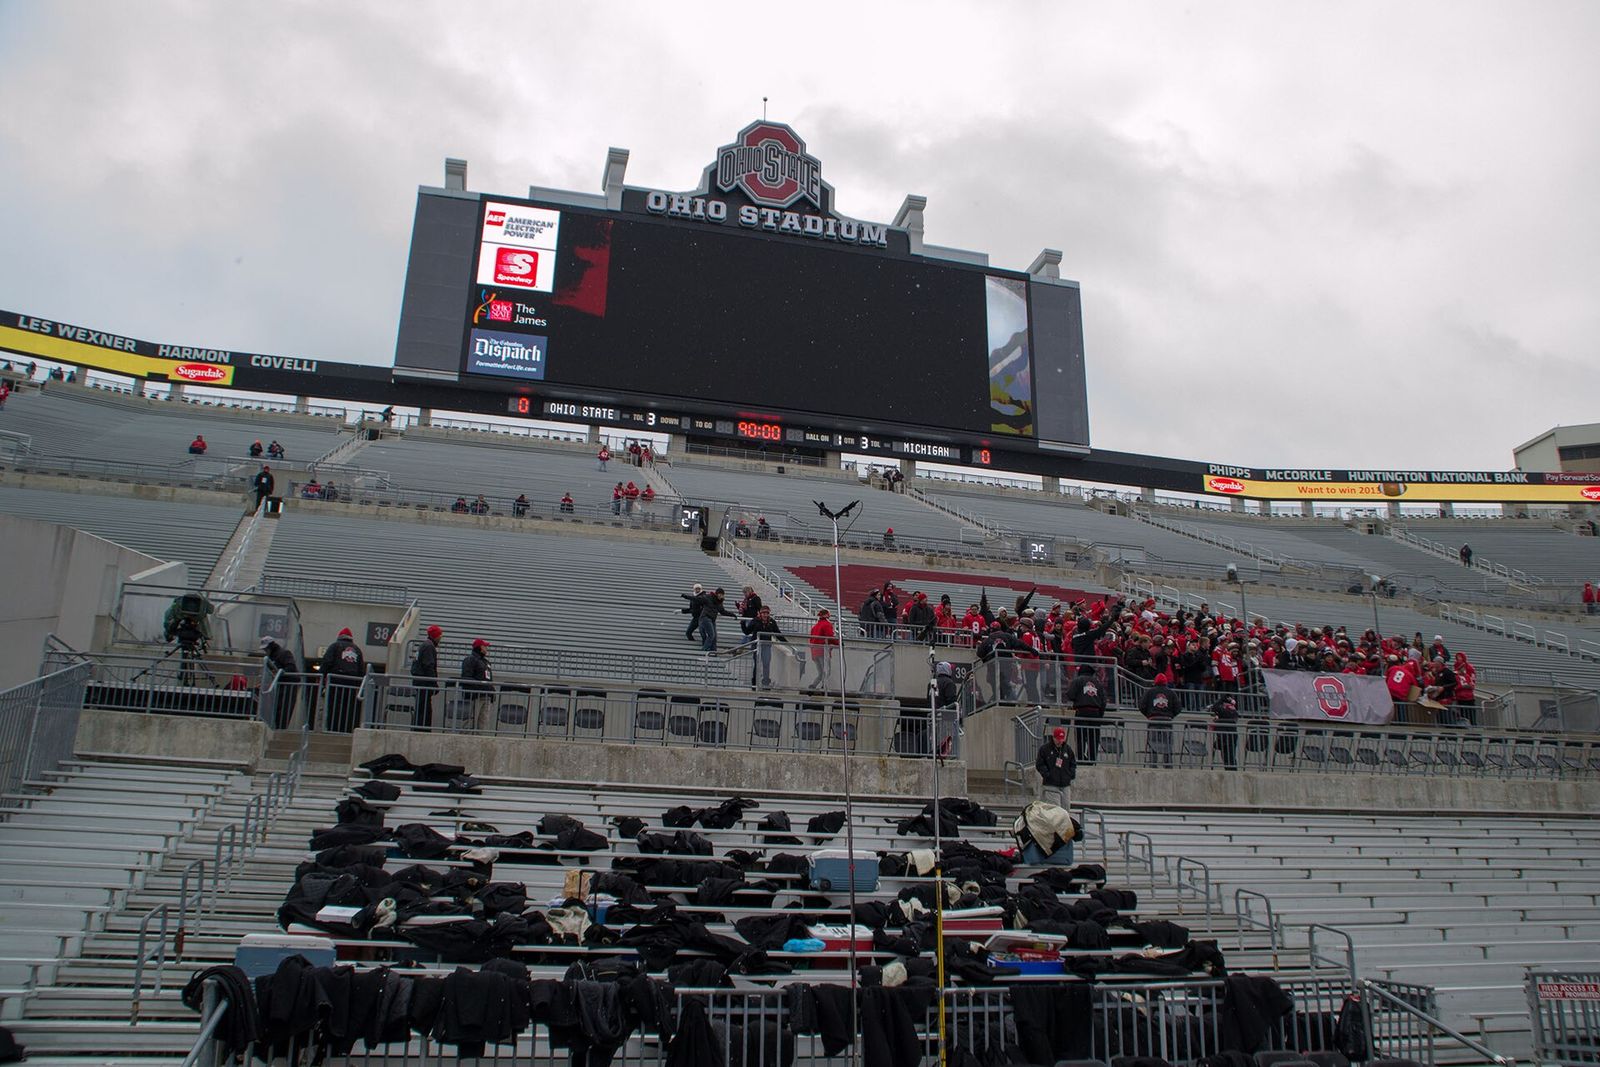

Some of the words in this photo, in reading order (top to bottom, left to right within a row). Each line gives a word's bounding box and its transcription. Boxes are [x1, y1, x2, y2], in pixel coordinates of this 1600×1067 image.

[508, 217, 554, 228] AMERICAN
[647, 191, 727, 222] OHIO
[739, 205, 888, 248] STADIUM
[505, 224, 543, 233] ELECTRIC
[504, 231, 535, 240] POWER
[496, 274, 533, 284] Speedway
[515, 303, 536, 315] The
[514, 315, 547, 327] James
[17, 315, 52, 333] LES
[57, 324, 136, 352] WEXNER
[158, 344, 230, 363] HARMON
[474, 338, 541, 362] Dispatch
[250, 354, 317, 373] COVELLI
[176, 366, 226, 380] Sugardale
[518, 397, 529, 414] 0
[550, 402, 576, 415] OHIO
[582, 407, 614, 420] STATE
[647, 412, 656, 426] 3
[660, 416, 679, 426] DOWN
[695, 420, 703, 428] TO
[738, 421, 781, 441] 90:00
[861, 437, 869, 449] 3
[904, 442, 949, 456] MICHIGAN
[981, 450, 991, 464] 0
[1209, 464, 1251, 479] PHIPPS
[1266, 470, 1332, 481] McCORKLE
[1348, 471, 1428, 483] HUNTINGTON
[1432, 472, 1491, 483] NATIONAL
[1495, 473, 1528, 483] BANK
[1546, 474, 1558, 482] Pay
[1209, 480, 1244, 491] Sugardale
[1298, 486, 1323, 494] Want
[266, 619, 282, 632] 36
[972, 621, 981, 634] 8
[373, 626, 389, 640] 38
[955, 666, 967, 679] 39
[1393, 671, 1405, 684] 8
[1560, 984, 1586, 992] ACCESS
